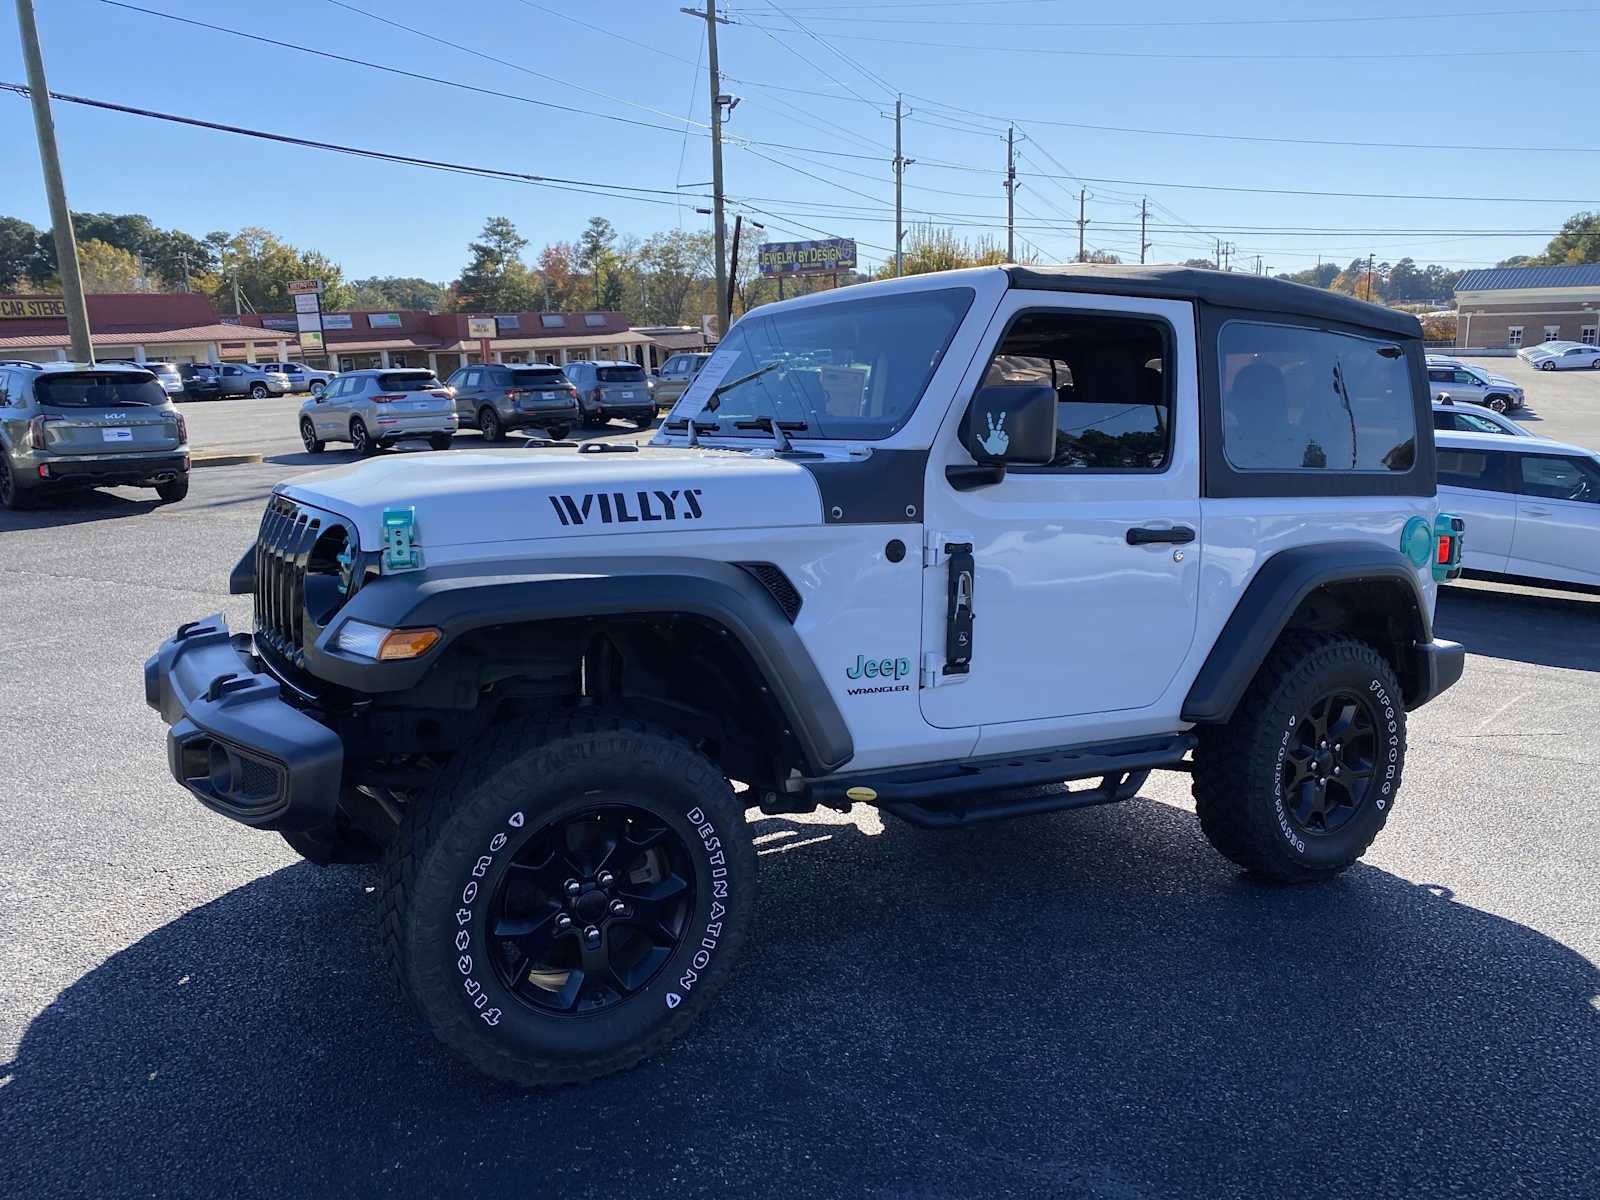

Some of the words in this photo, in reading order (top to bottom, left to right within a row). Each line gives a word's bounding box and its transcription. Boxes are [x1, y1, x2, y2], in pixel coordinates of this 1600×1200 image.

[760, 250, 797, 265] JEWELRY
[798, 251, 808, 263] BY
[810, 246, 842, 263] DESIGN
[1, 301, 25, 316] CAR
[28, 301, 65, 316] STERE
[548, 489, 703, 526] WILLYS
[846, 654, 910, 681] Jeep
[847, 685, 909, 696] WRANGLER
[1369, 680, 1399, 795] Firestone
[1274, 731, 1305, 853] DESTINATION
[680, 806, 728, 990] DESTINATION
[455, 832, 508, 1026] Firestone
